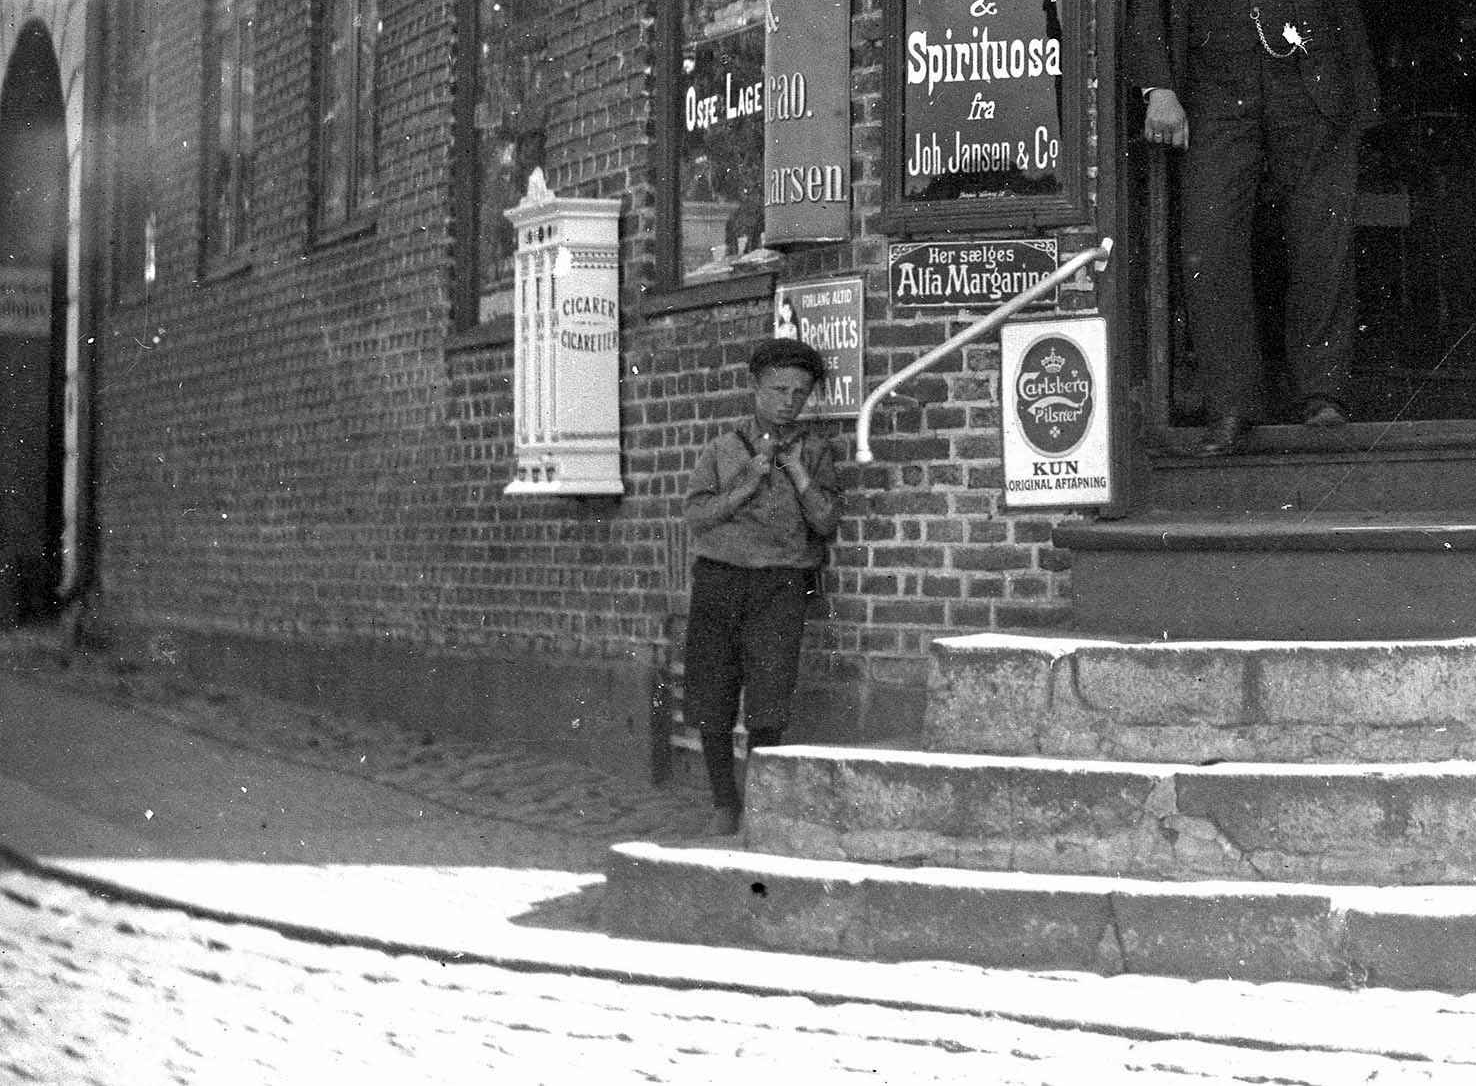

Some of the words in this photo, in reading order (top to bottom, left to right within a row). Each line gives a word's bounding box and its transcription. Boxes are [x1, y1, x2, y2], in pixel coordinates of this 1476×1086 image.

[907, 26, 1062, 96] Spirituosa
[686, 86, 718, 132] OSTE
[726, 72, 763, 120] LAGE
[766, 72, 813, 122] cao.
[967, 92, 995, 120] fra
[909, 132, 946, 176] Joh.
[948, 131, 1010, 174] Jansen
[1016, 140, 1029, 170] &
[928, 247, 956, 264] Her
[960, 246, 1015, 269] sælges
[897, 262, 943, 297] Alfa
[801, 315, 858, 351] Reckitt's
[1018, 372, 1089, 401] Carlsberg
[1035, 407, 1083, 424] Pilsner
[1008, 478, 1052, 492] ORIGINAL
[1055, 476, 1106, 490] AFTAPNING
[1033, 461, 1079, 476] KUN
